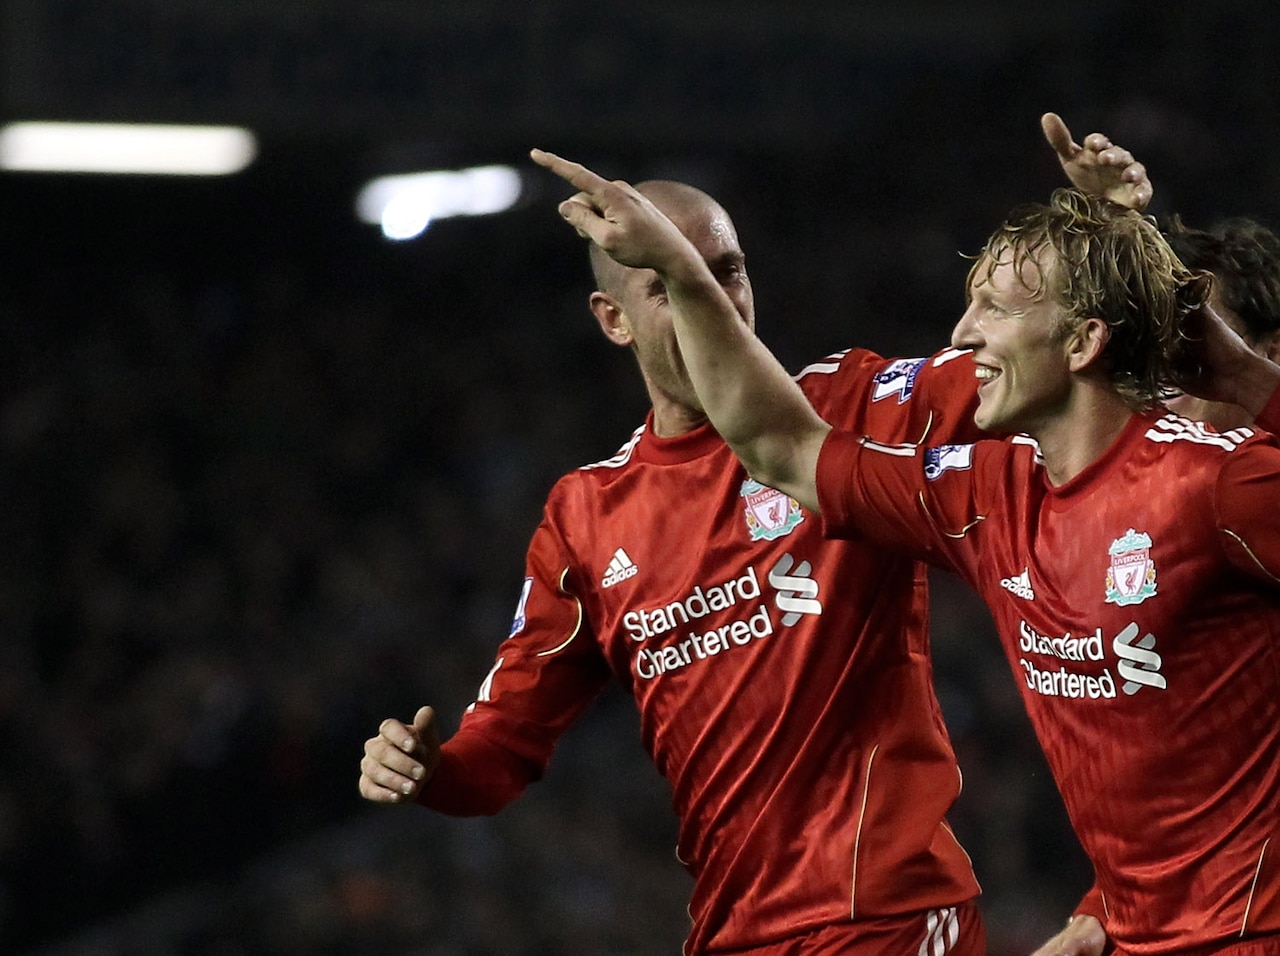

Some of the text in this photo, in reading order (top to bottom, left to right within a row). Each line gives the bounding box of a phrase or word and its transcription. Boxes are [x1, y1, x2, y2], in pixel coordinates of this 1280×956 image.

[602, 565, 639, 588] adidas
[1114, 553, 1146, 566] LIVERPOOL
[623, 566, 761, 641] Standard
[636, 605, 774, 679] Chartered
[1020, 620, 1104, 661] Standard
[1020, 658, 1116, 698] Chartered
